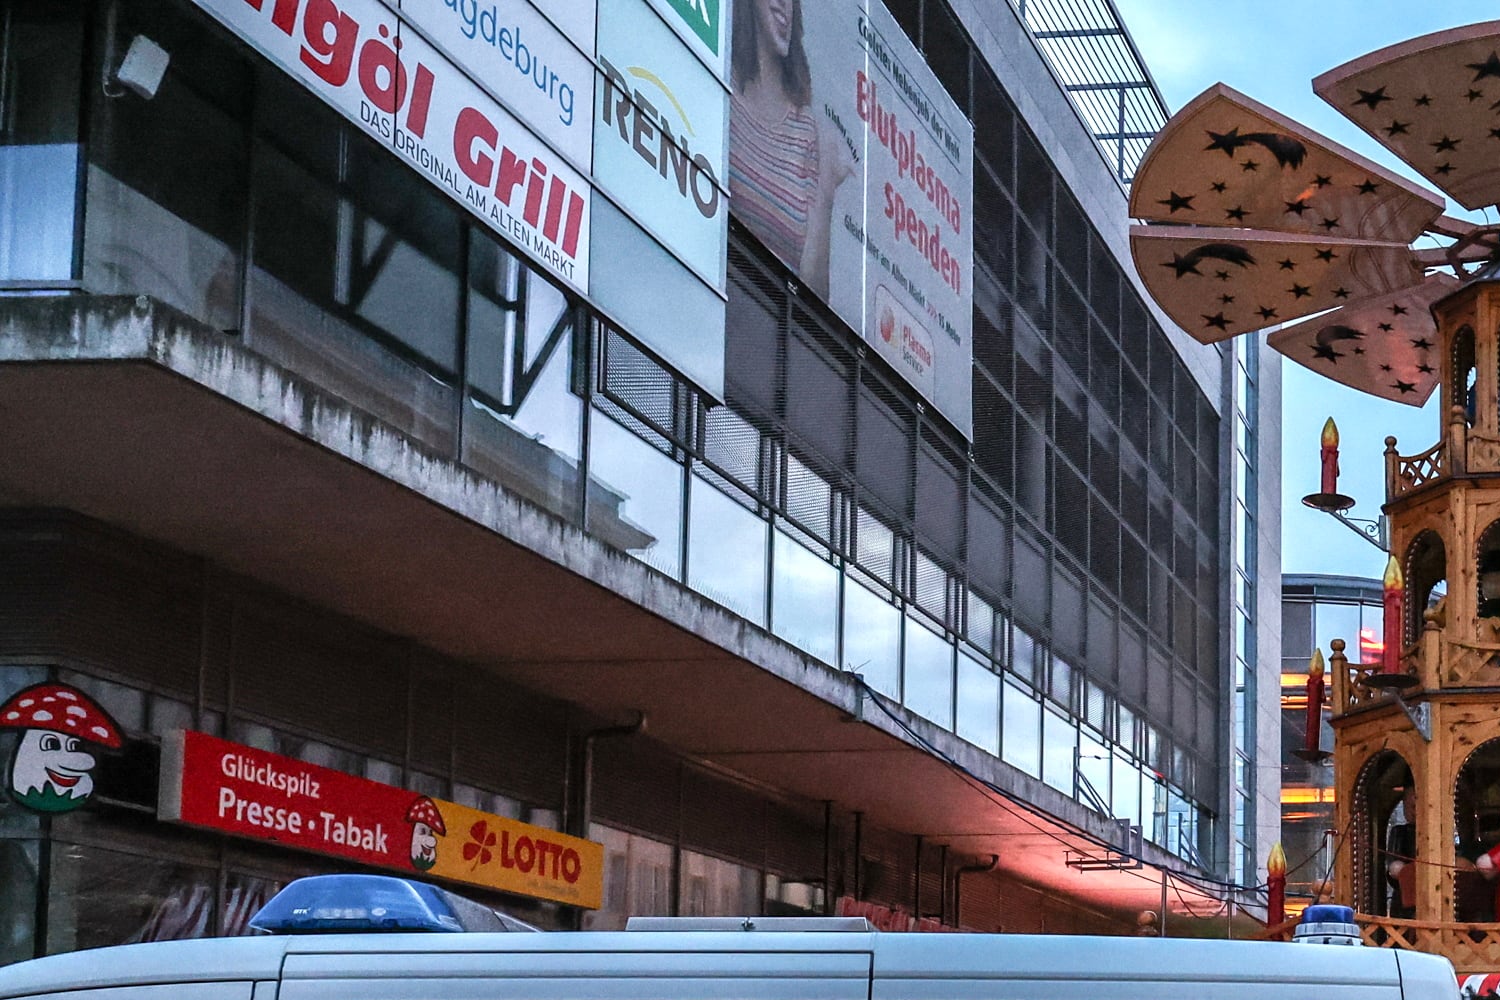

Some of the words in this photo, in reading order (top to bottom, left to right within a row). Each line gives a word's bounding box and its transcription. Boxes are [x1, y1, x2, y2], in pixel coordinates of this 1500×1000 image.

[600, 54, 719, 219] RENO
[892, 61, 930, 123] Nebenjob
[931, 111, 943, 140] der
[361, 100, 390, 138] DAS
[396, 128, 462, 195] ORIGINAL
[466, 185, 486, 213] AM
[490, 204, 530, 246] ALTEN
[533, 235, 575, 280] MARKT
[453, 107, 584, 260] Grill
[856, 70, 960, 235] Blutplasma
[884, 182, 960, 296] spenden
[903, 325, 931, 367] Plasma
[218, 787, 302, 834] Presse
[320, 811, 388, 853] Tabak
[221, 753, 320, 798] Glückspilz
[501, 830, 581, 884] LOTTO
